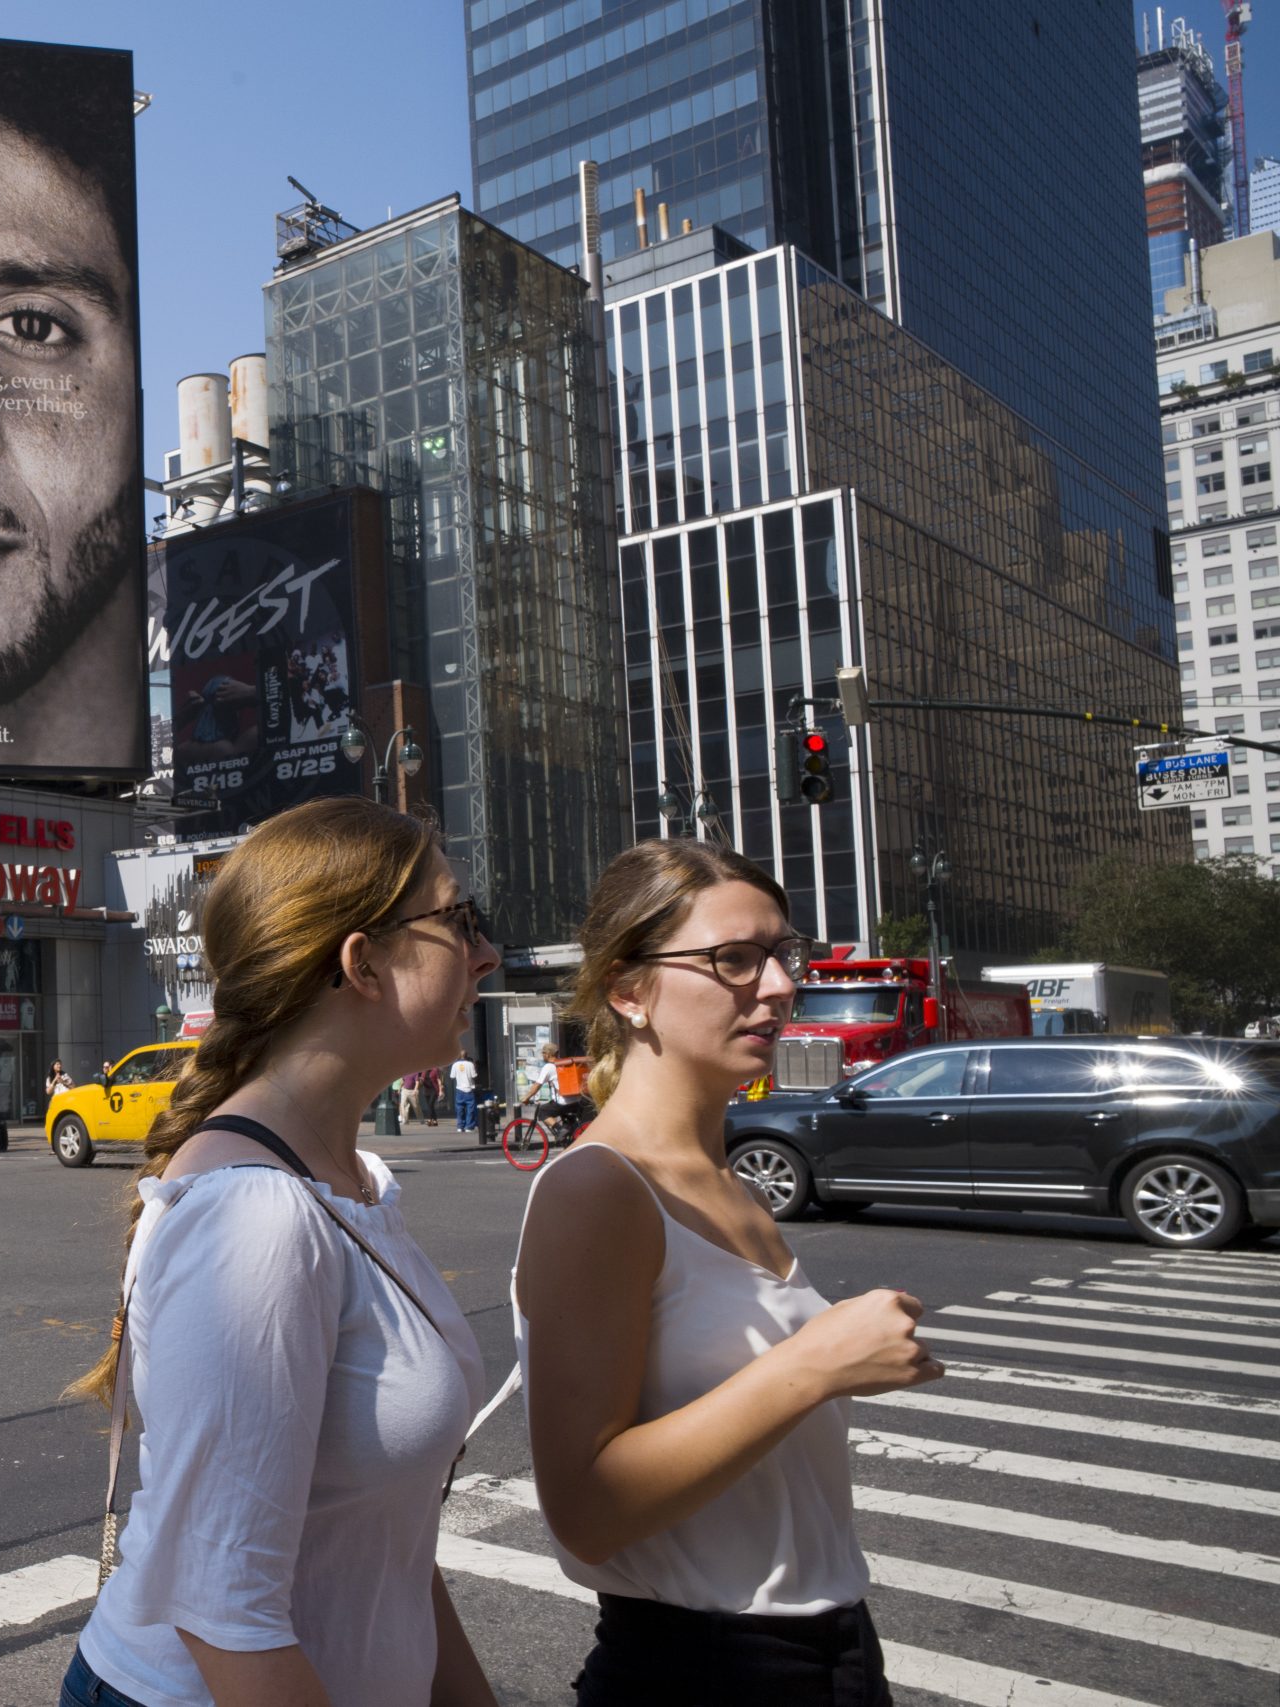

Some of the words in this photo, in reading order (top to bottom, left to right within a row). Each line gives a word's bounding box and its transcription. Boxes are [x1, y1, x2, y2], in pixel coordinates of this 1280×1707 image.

[11, 376, 54, 391] even
[56, 374, 73, 392] if
[273, 746, 307, 761] ASAP
[309, 741, 338, 755] MOB
[186, 760, 218, 776] ASAP
[219, 756, 250, 770] FERG
[276, 755, 336, 780] 8/25
[1165, 759, 1186, 769] BUS
[1189, 754, 1218, 766] LANE
[193, 770, 244, 793] 8/18
[1146, 769, 1185, 782] BUSES
[1189, 764, 1222, 776] ONLY
[1171, 782, 1193, 792] 7AM
[1203, 778, 1225, 788] 7PM
[1173, 791, 1196, 800] MON
[1207, 788, 1224, 797] FRI
[1026, 978, 1074, 997] ABF
